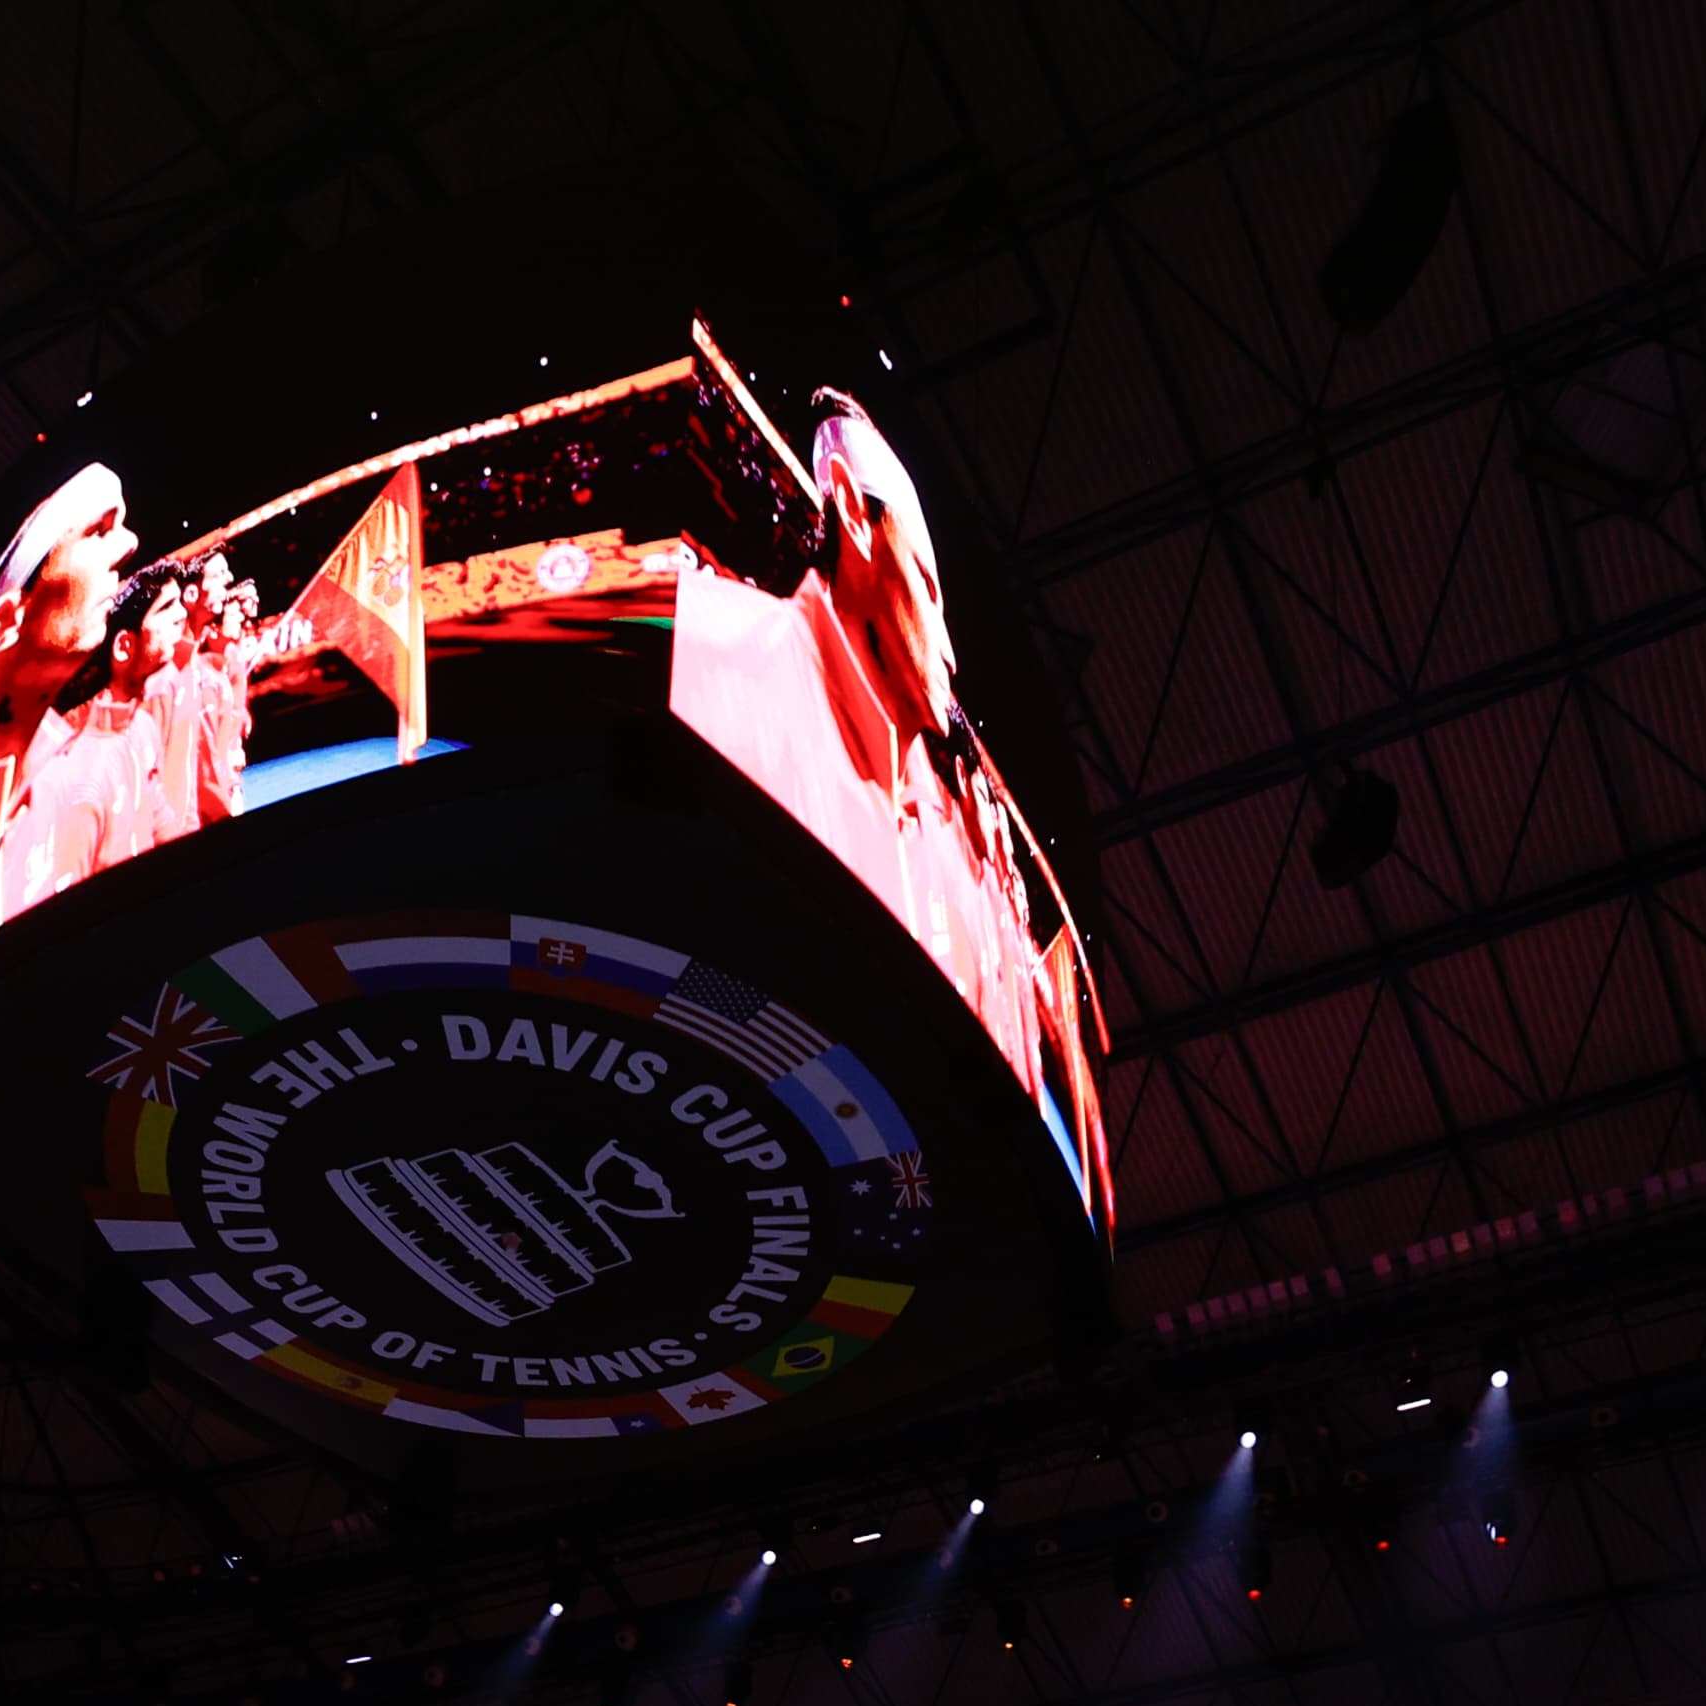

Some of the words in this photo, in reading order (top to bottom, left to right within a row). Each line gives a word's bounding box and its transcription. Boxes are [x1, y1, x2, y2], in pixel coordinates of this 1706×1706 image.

[250, 1026, 395, 1108] THE
[441, 1013, 667, 1098] DAVIS
[669, 1084, 787, 1174] CUP
[201, 1101, 288, 1254] WORLD
[252, 1263, 367, 1333] CUP
[709, 1184, 810, 1332] FINALS
[371, 1331, 456, 1370] OF
[472, 1337, 697, 1386] TENNIS
